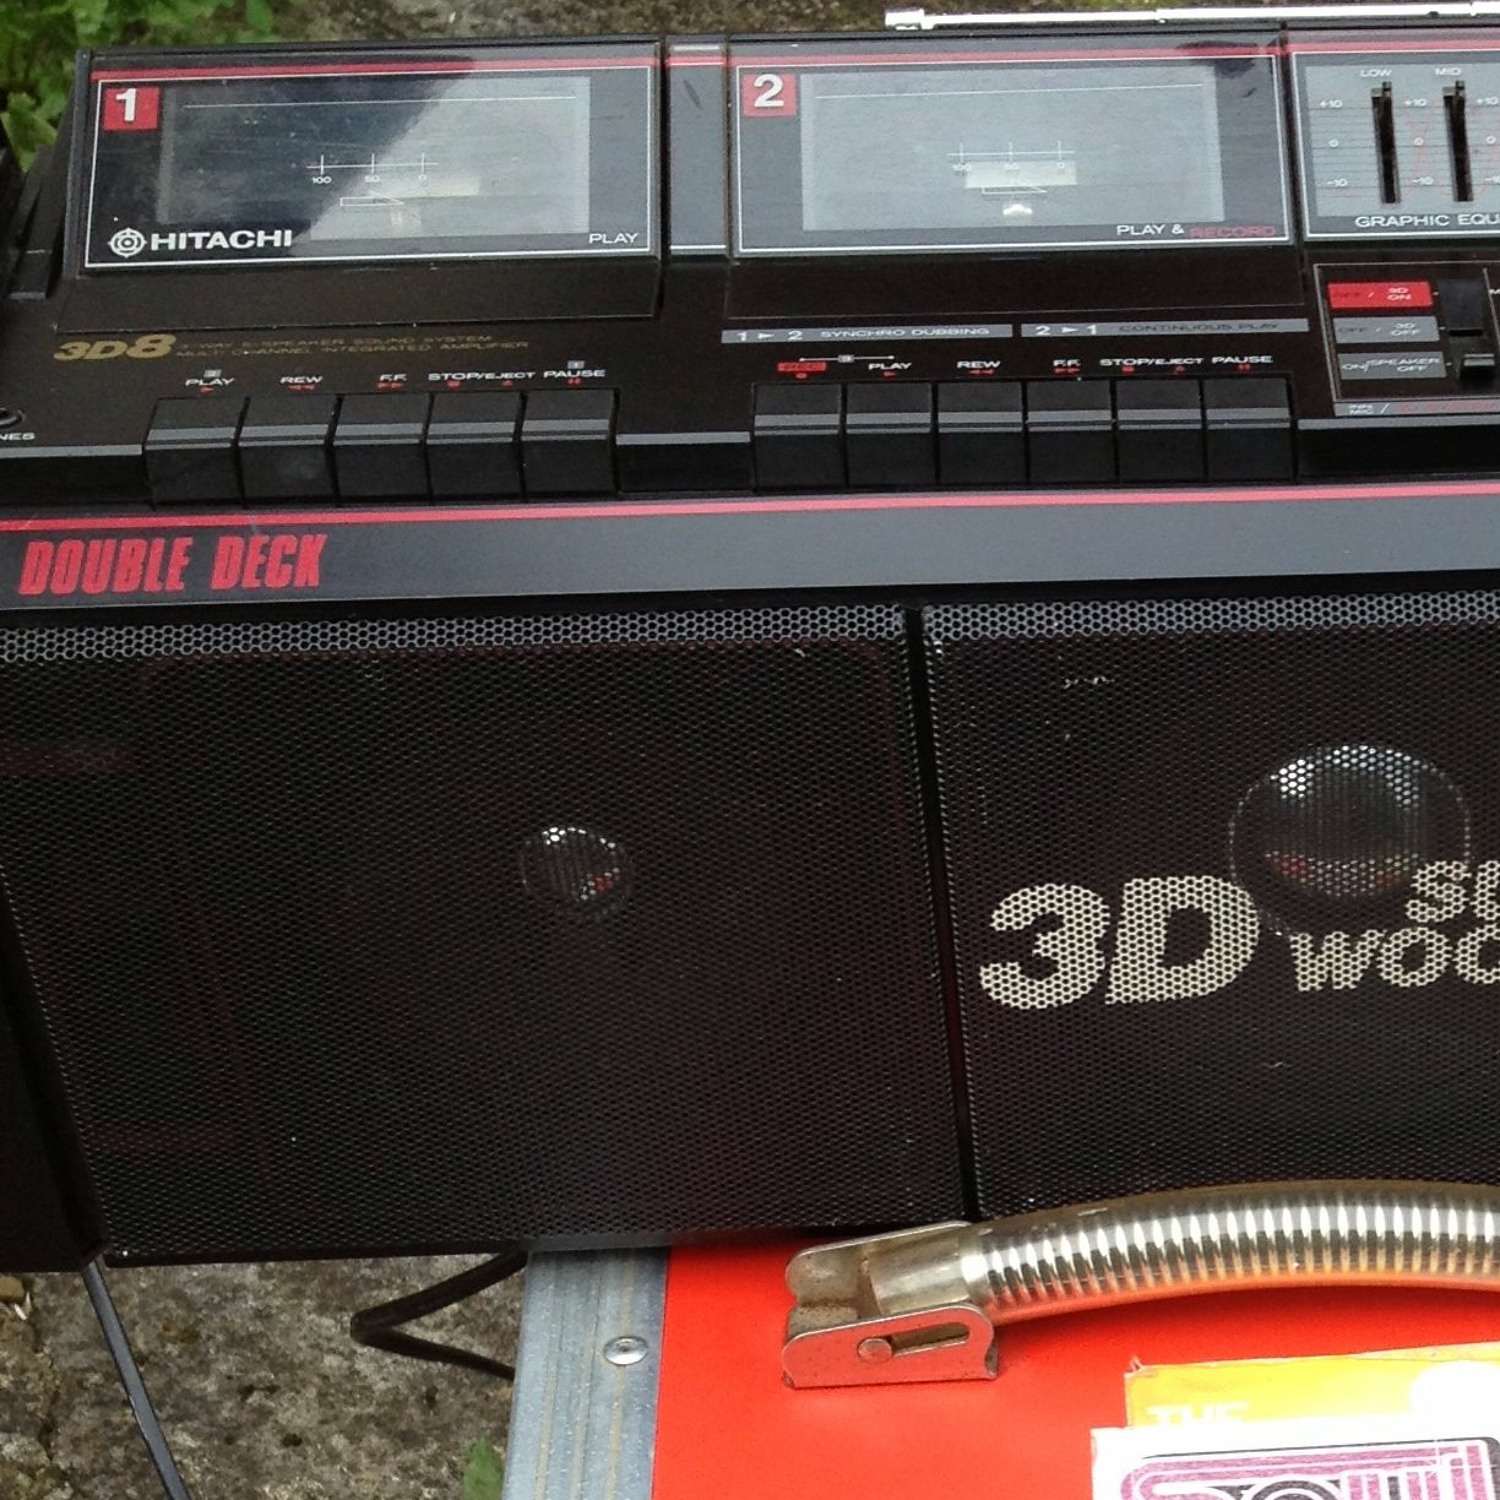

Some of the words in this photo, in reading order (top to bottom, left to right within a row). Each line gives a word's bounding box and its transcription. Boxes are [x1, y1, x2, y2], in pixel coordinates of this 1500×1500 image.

[1360, 68, 1392, 78] LOW
[1435, 67, 1463, 77] MID
[753, 75, 784, 108] 2
[116, 88, 138, 121] 1
[1319, 99, 1342, 109] +10
[1404, 98, 1427, 107] +10
[1476, 96, 1499, 106] +10
[1328, 138, 1339, 148] 0
[1413, 137, 1424, 147] 0
[1486, 135, 1496, 145] 0
[312, 175, 332, 184] 100
[364, 174, 380, 183] 50
[418, 173, 427, 181] 0
[1326, 178, 1348, 187] -10
[1412, 176, 1433, 186] -10
[1355, 214, 1450, 228] GRAPHIC
[1116, 224, 1166, 236] PLAY
[1171, 223, 1185, 234] &
[1190, 225, 1277, 238] RECORD
[150, 229, 293, 252] HITACHI
[588, 232, 639, 246] PLAY
[736, 331, 748, 342] 1
[787, 330, 804, 341] 2
[820, 328, 906, 339] SYNCHRO
[911, 327, 991, 337] DUBBING
[1035, 325, 1051, 336] 2
[1086, 324, 1098, 335] 1
[1119, 322, 1233, 333] CONTINUOUS
[1237, 321, 1279, 331] PLAY
[53, 333, 177, 362] 3D8
[868, 361, 912, 371] PLAY
[956, 360, 1001, 369] REW
[1099, 356, 1205, 367] STOP/EJECT
[1211, 355, 1274, 365] PAUSE
[185, 377, 235, 387] PLAY
[280, 375, 323, 385] REW
[428, 371, 536, 382] STOP/EJECT
[543, 368, 607, 379] PAUSE
[19, 536, 194, 595] DOUBLE
[210, 533, 328, 590] DECK
[979, 873, 1260, 1010] 3D
